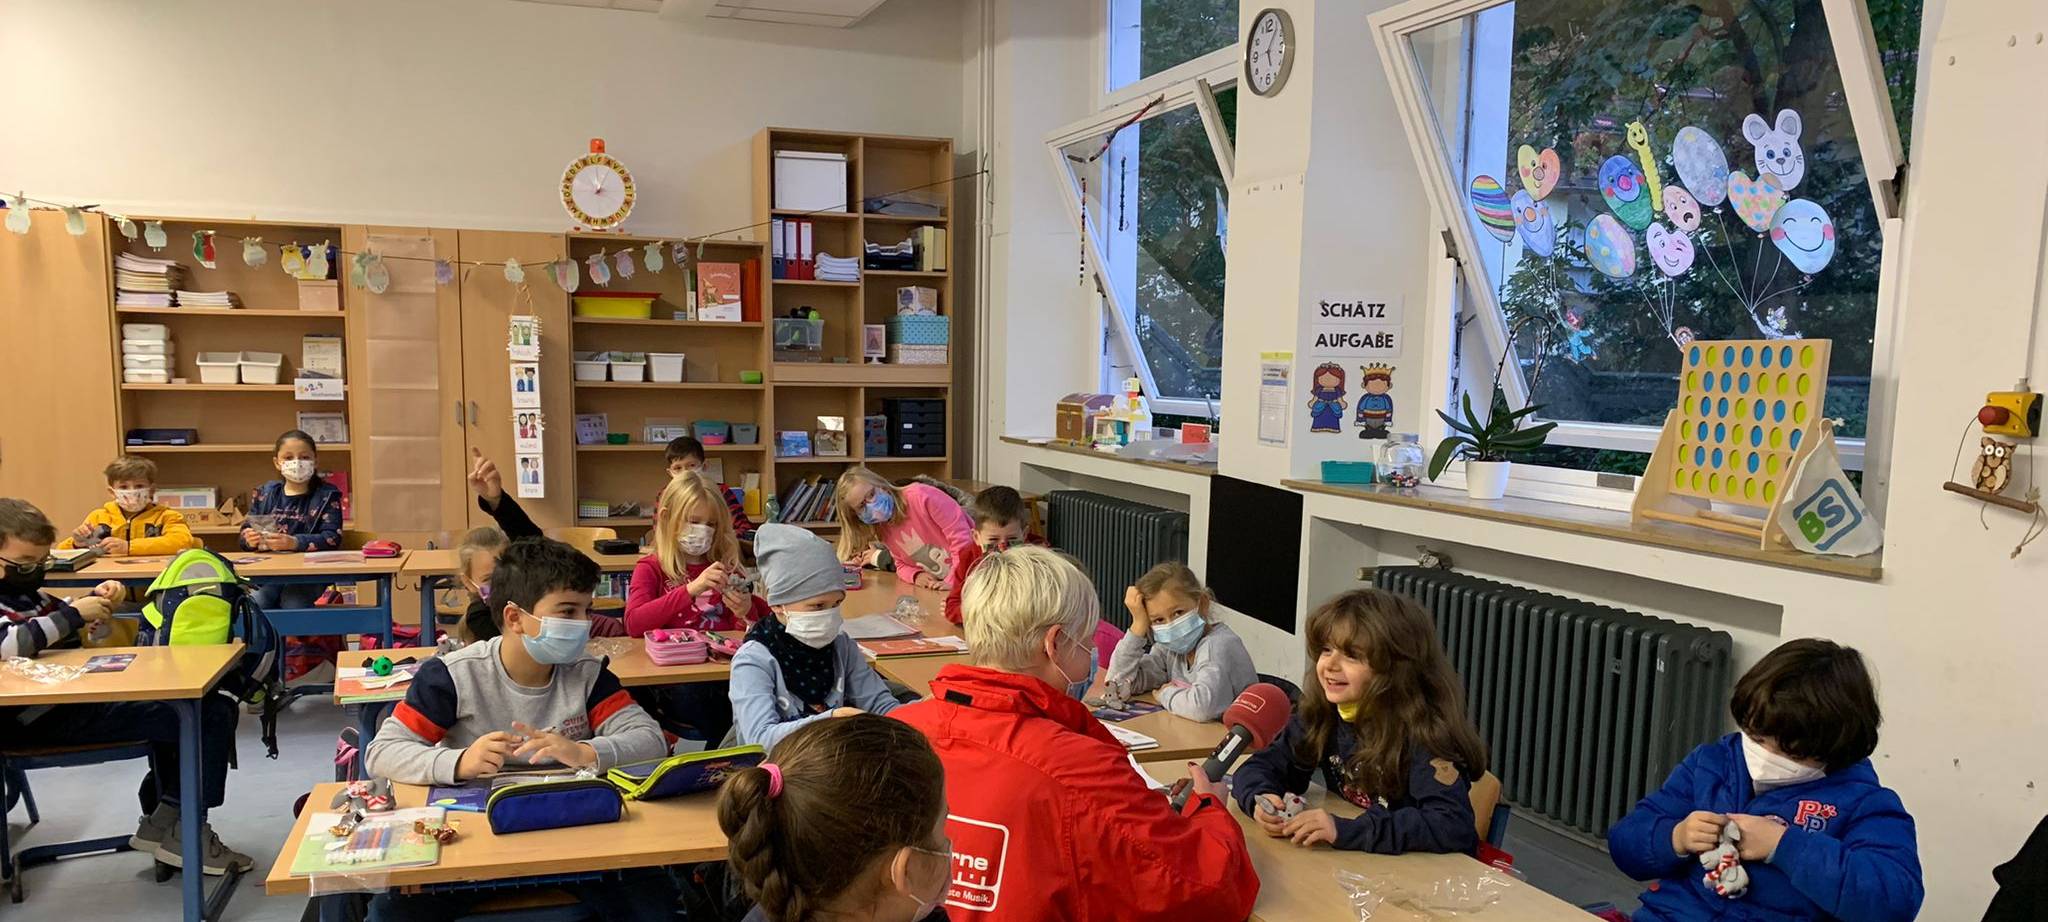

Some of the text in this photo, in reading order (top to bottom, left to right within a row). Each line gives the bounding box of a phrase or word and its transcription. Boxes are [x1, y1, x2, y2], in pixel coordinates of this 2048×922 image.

[1266, 18, 1274, 32] 12
[1320, 301, 1385, 318] SCHÄTZ
[1314, 333, 1394, 348] AUFGABE
[952, 852, 988, 871] rne
[947, 888, 991, 904] ste Musik.
